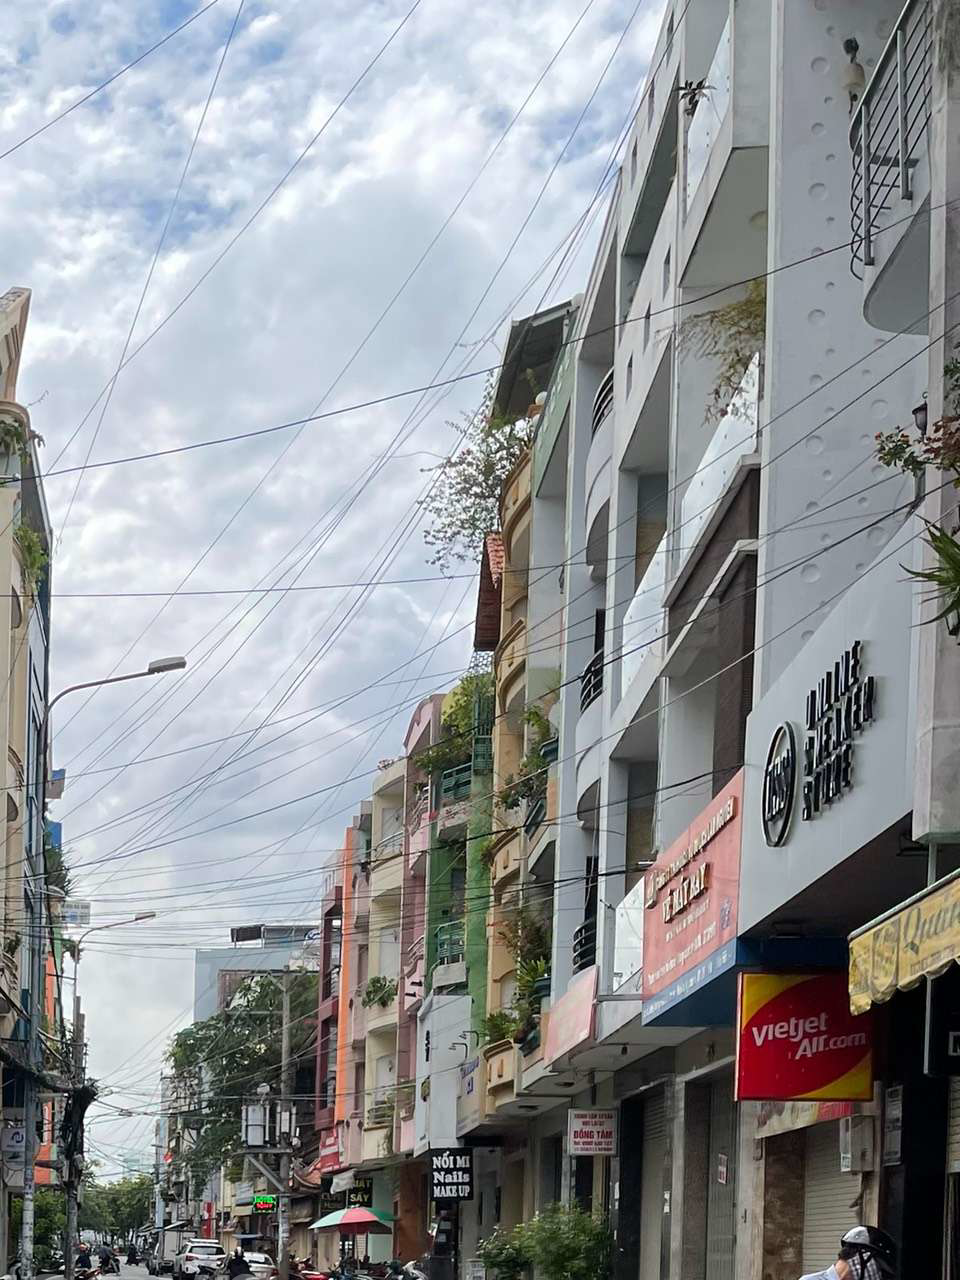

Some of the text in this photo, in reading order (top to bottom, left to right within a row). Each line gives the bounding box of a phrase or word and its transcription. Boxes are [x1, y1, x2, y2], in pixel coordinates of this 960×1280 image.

[795, 1032, 866, 1060] Air.com
[432, 1151, 470, 1168] NỐI MI
[432, 1171, 470, 1183] Nails
[433, 1185, 470, 1198] MAKE UP
